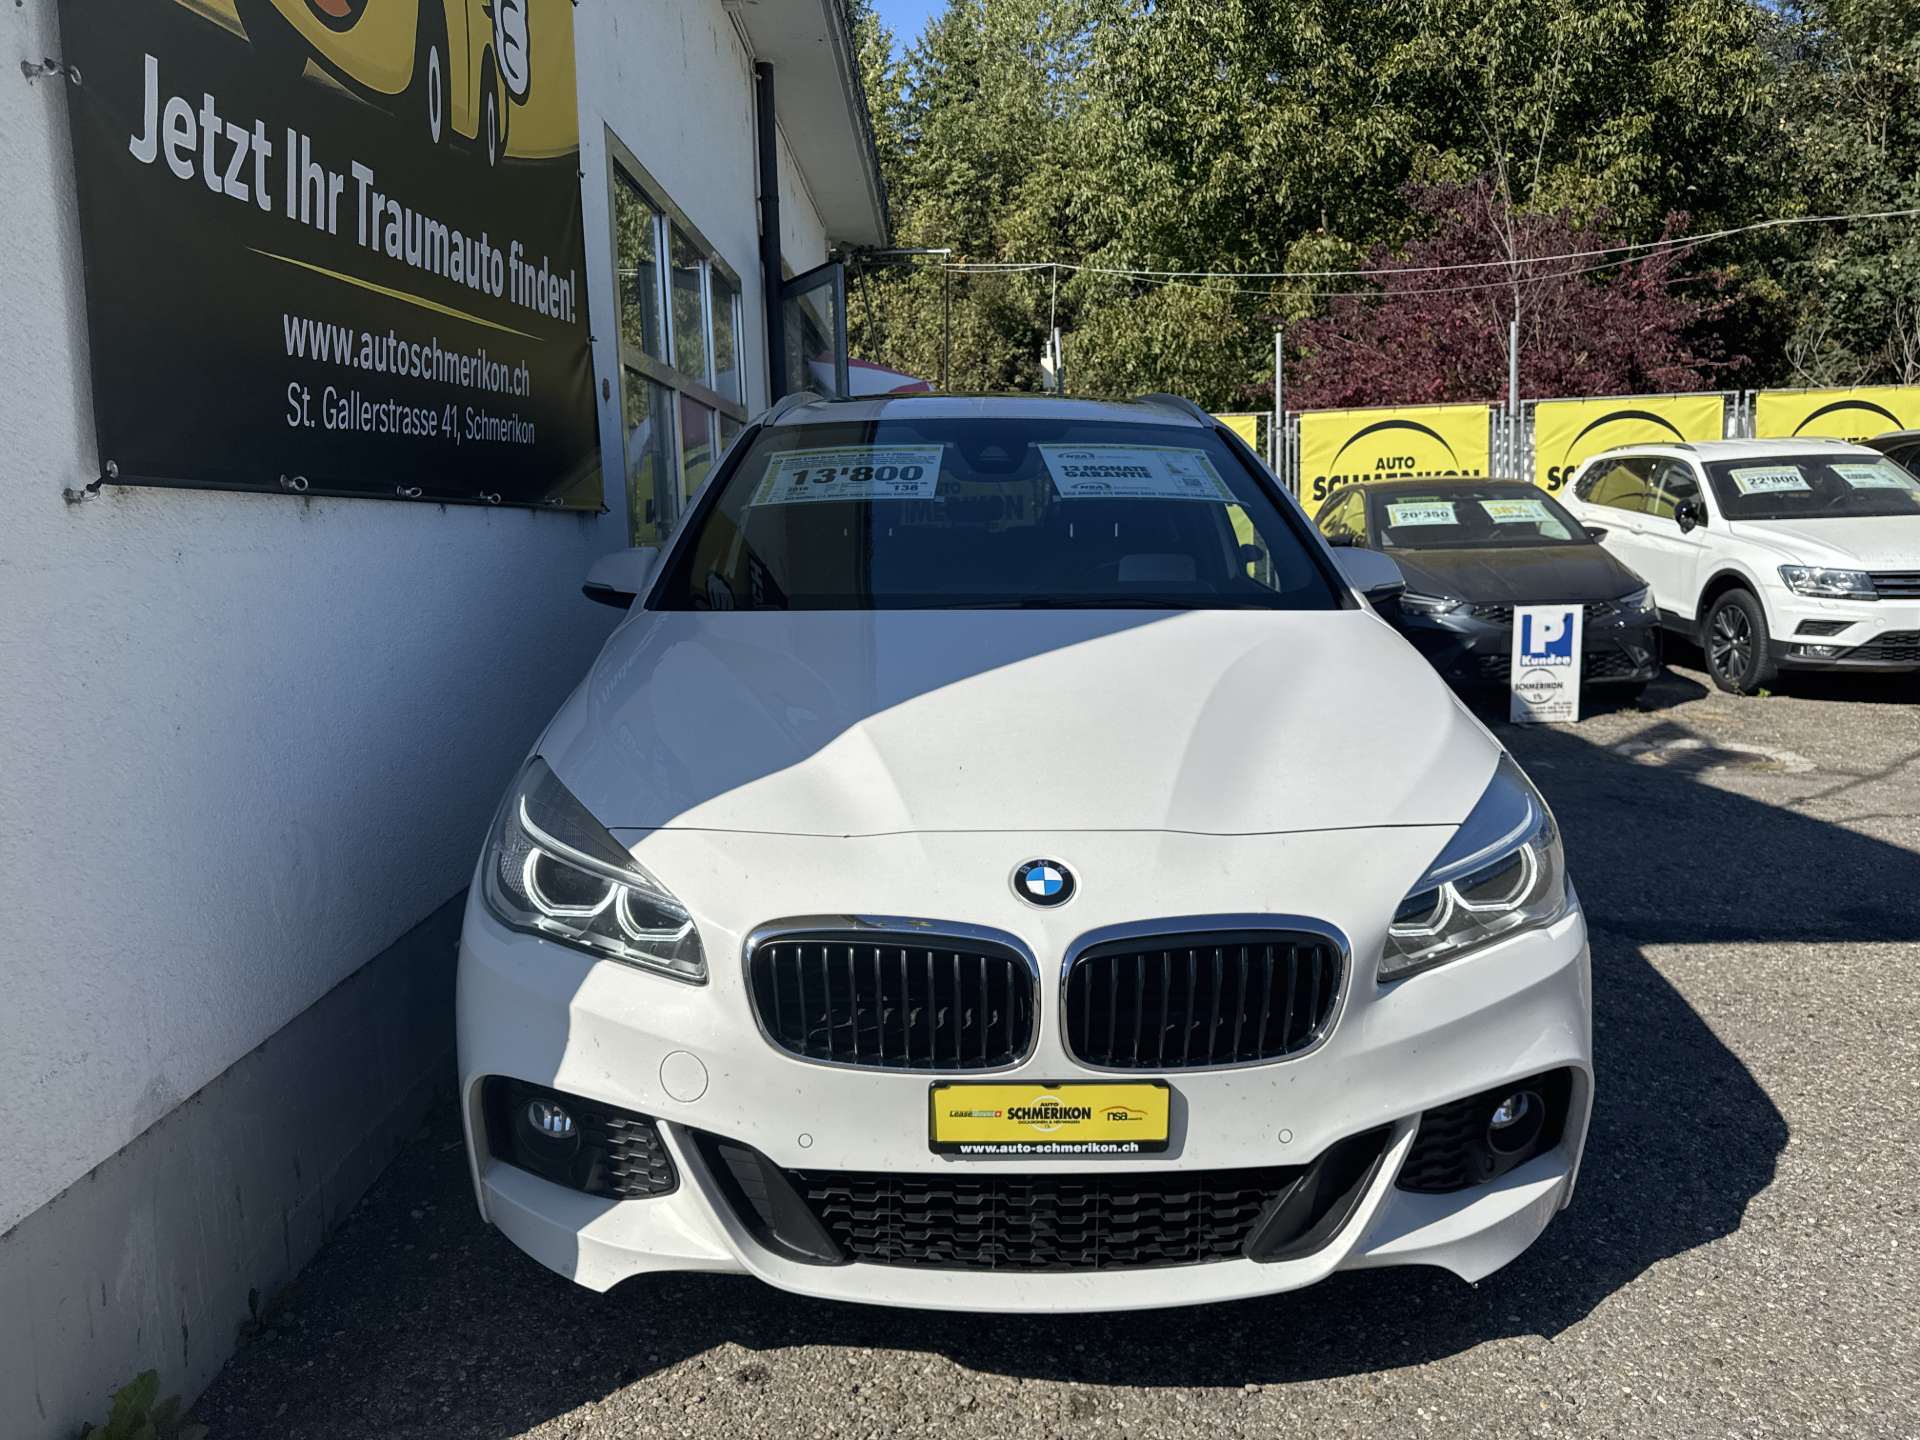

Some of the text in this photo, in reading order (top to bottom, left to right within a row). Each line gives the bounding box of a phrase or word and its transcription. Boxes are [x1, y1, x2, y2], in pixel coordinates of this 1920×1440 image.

[129, 53, 577, 323] Jetzt Ihr Traumauto finden!
[283, 313, 530, 398] www.autoschmerikon.ch
[286, 382, 535, 446] St. Gallerstrasse 41, Schmerikon
[1376, 456, 1415, 470] AUTO
[792, 466, 924, 485] 13'800
[1521, 653, 1571, 666] Kunden
[1007, 1107, 1091, 1120] SCHMERIKON
[1108, 1110, 1128, 1121] nsa
[960, 1142, 1139, 1154] www.auto-schmerikon.ch
